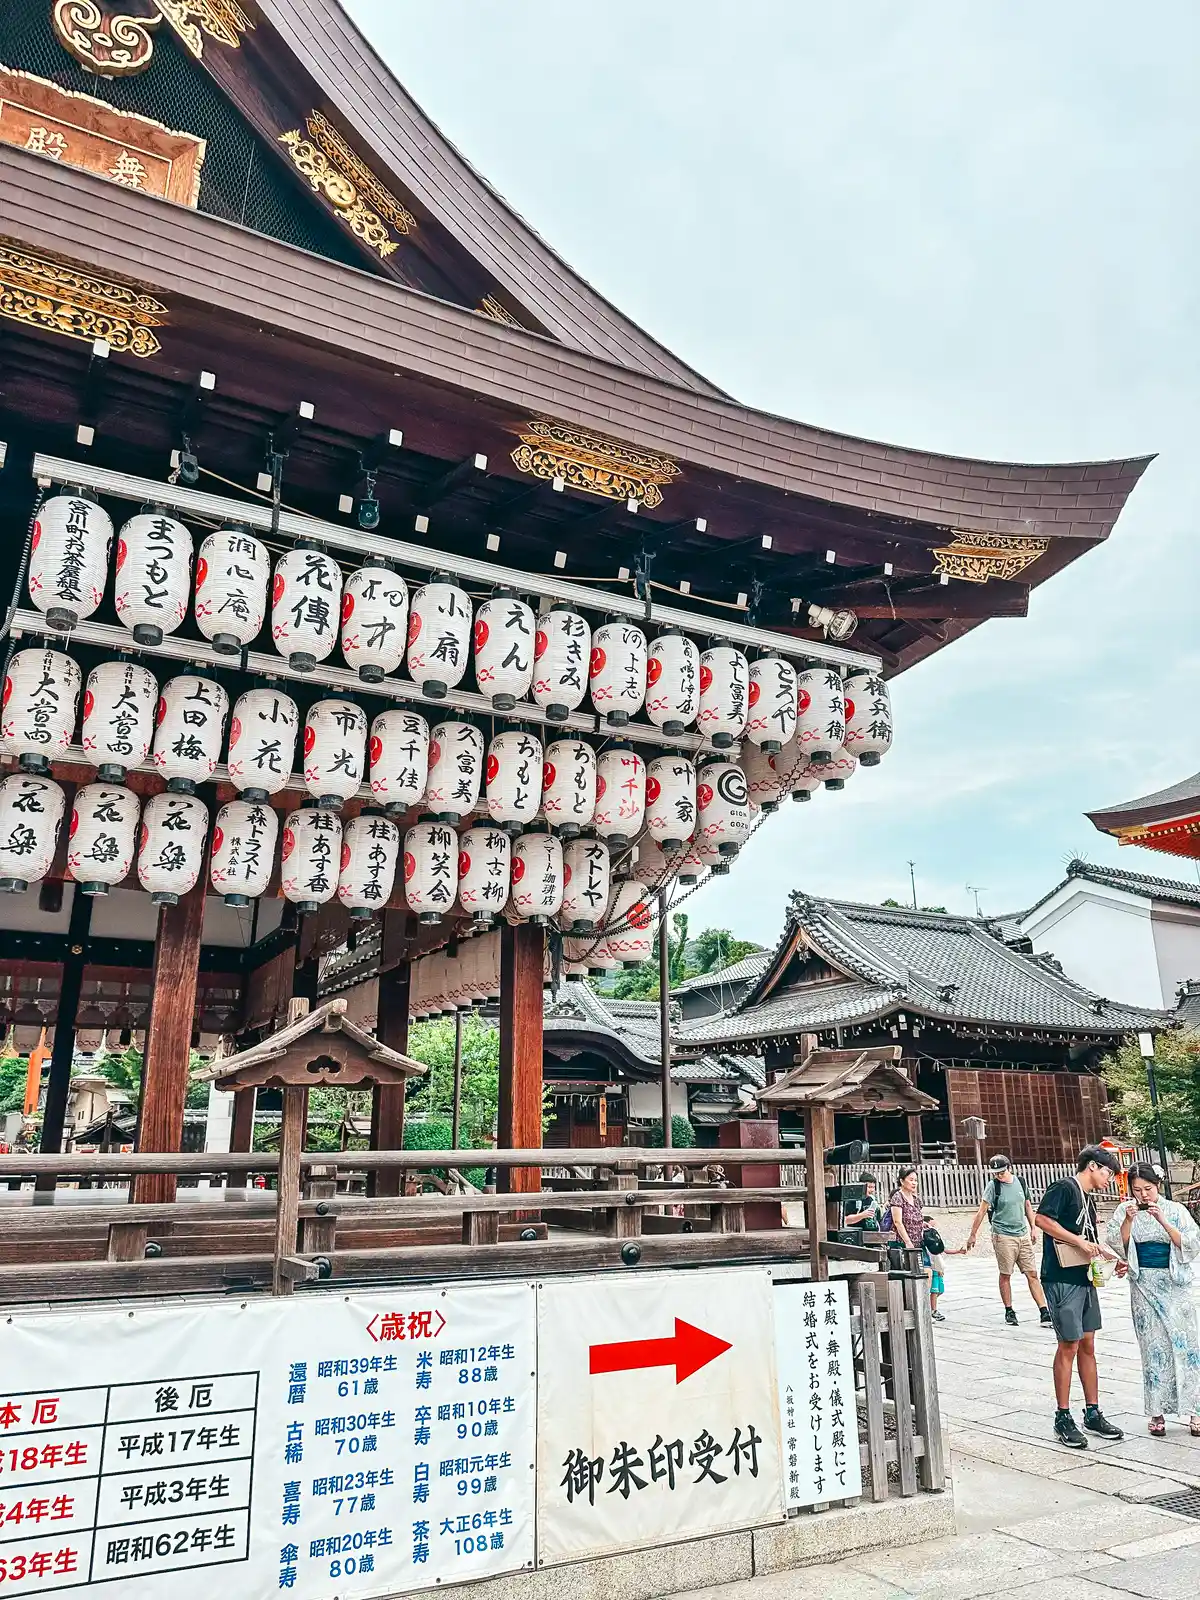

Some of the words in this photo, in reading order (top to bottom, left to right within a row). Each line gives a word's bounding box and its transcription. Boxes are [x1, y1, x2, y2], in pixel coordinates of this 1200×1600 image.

[52, 500, 93, 603] 宮川町お茶屋組合
[142, 518, 175, 609] まつもと
[430, 592, 465, 667] 小扇
[501, 603, 530, 672] えん
[559, 616, 585, 690] 杉きみ
[172, 681, 213, 761] 上田梅
[823, 673, 844, 740] 権兵衛
[863, 677, 892, 742] 権兵衛
[249, 698, 289, 773] 小花
[326, 706, 359, 778] 市光
[396, 715, 421, 790] 豆千佳
[451, 726, 477, 803] 久富美
[513, 736, 535, 810] ちもと
[572, 743, 590, 814] ちもと
[672, 763, 694, 823] 叶家
[226, 836, 241, 876] 株式会社
[241, 805, 268, 880] 森トラスト
[304, 812, 334, 893] 桂あす香
[360, 820, 391, 900] 桂あす香
[426, 827, 451, 903] 柳笑会
[481, 831, 506, 903] 柳古柳
[541, 836, 557, 906] スマート珈琲店
[581, 843, 604, 907] カトレヤ
[317, 1355, 398, 1379] 昭和39年生
[415, 1351, 433, 1390] 米寿
[439, 1343, 515, 1366] 昭和12年生
[458, 1366, 498, 1384] 88歳
[287, 1362, 307, 1405] 還暦
[337, 1377, 379, 1397] 61歳
[802, 1290, 826, 1495] 結婚式をお受けします
[823, 1288, 847, 1486] 本殿・舞殿・儀式殿にて
[314, 1410, 396, 1436] 昭和30年生
[414, 1405, 432, 1446] 卒寿
[437, 1396, 516, 1421] 昭和10年生
[456, 1420, 498, 1439] 90歳
[0, 1440, 88, 1474] 18年生
[117, 1423, 240, 1459] 平成17年生
[284, 1421, 304, 1465] 古稀
[334, 1434, 377, 1456] 70歳
[439, 1451, 512, 1477] 昭和元年生
[312, 1468, 394, 1496] 昭和23年生
[412, 1462, 430, 1504] 白寿
[456, 1476, 497, 1496] 99歳
[559, 1424, 762, 1506] 御朱印受付
[787, 1437, 800, 1500] 常磐新殿
[120, 1474, 230, 1510] 平成3年生
[282, 1480, 301, 1526] 喜寿
[332, 1493, 375, 1516] 77歳
[105, 1523, 236, 1565] 昭和62年生
[309, 1527, 393, 1558] 昭和20年生
[412, 1521, 429, 1564] 茶寿
[439, 1508, 513, 1536] 大正6年生
[454, 1532, 504, 1556] 108歳
[278, 1543, 299, 1590] 傘寿
[329, 1554, 375, 1579] 80歳
